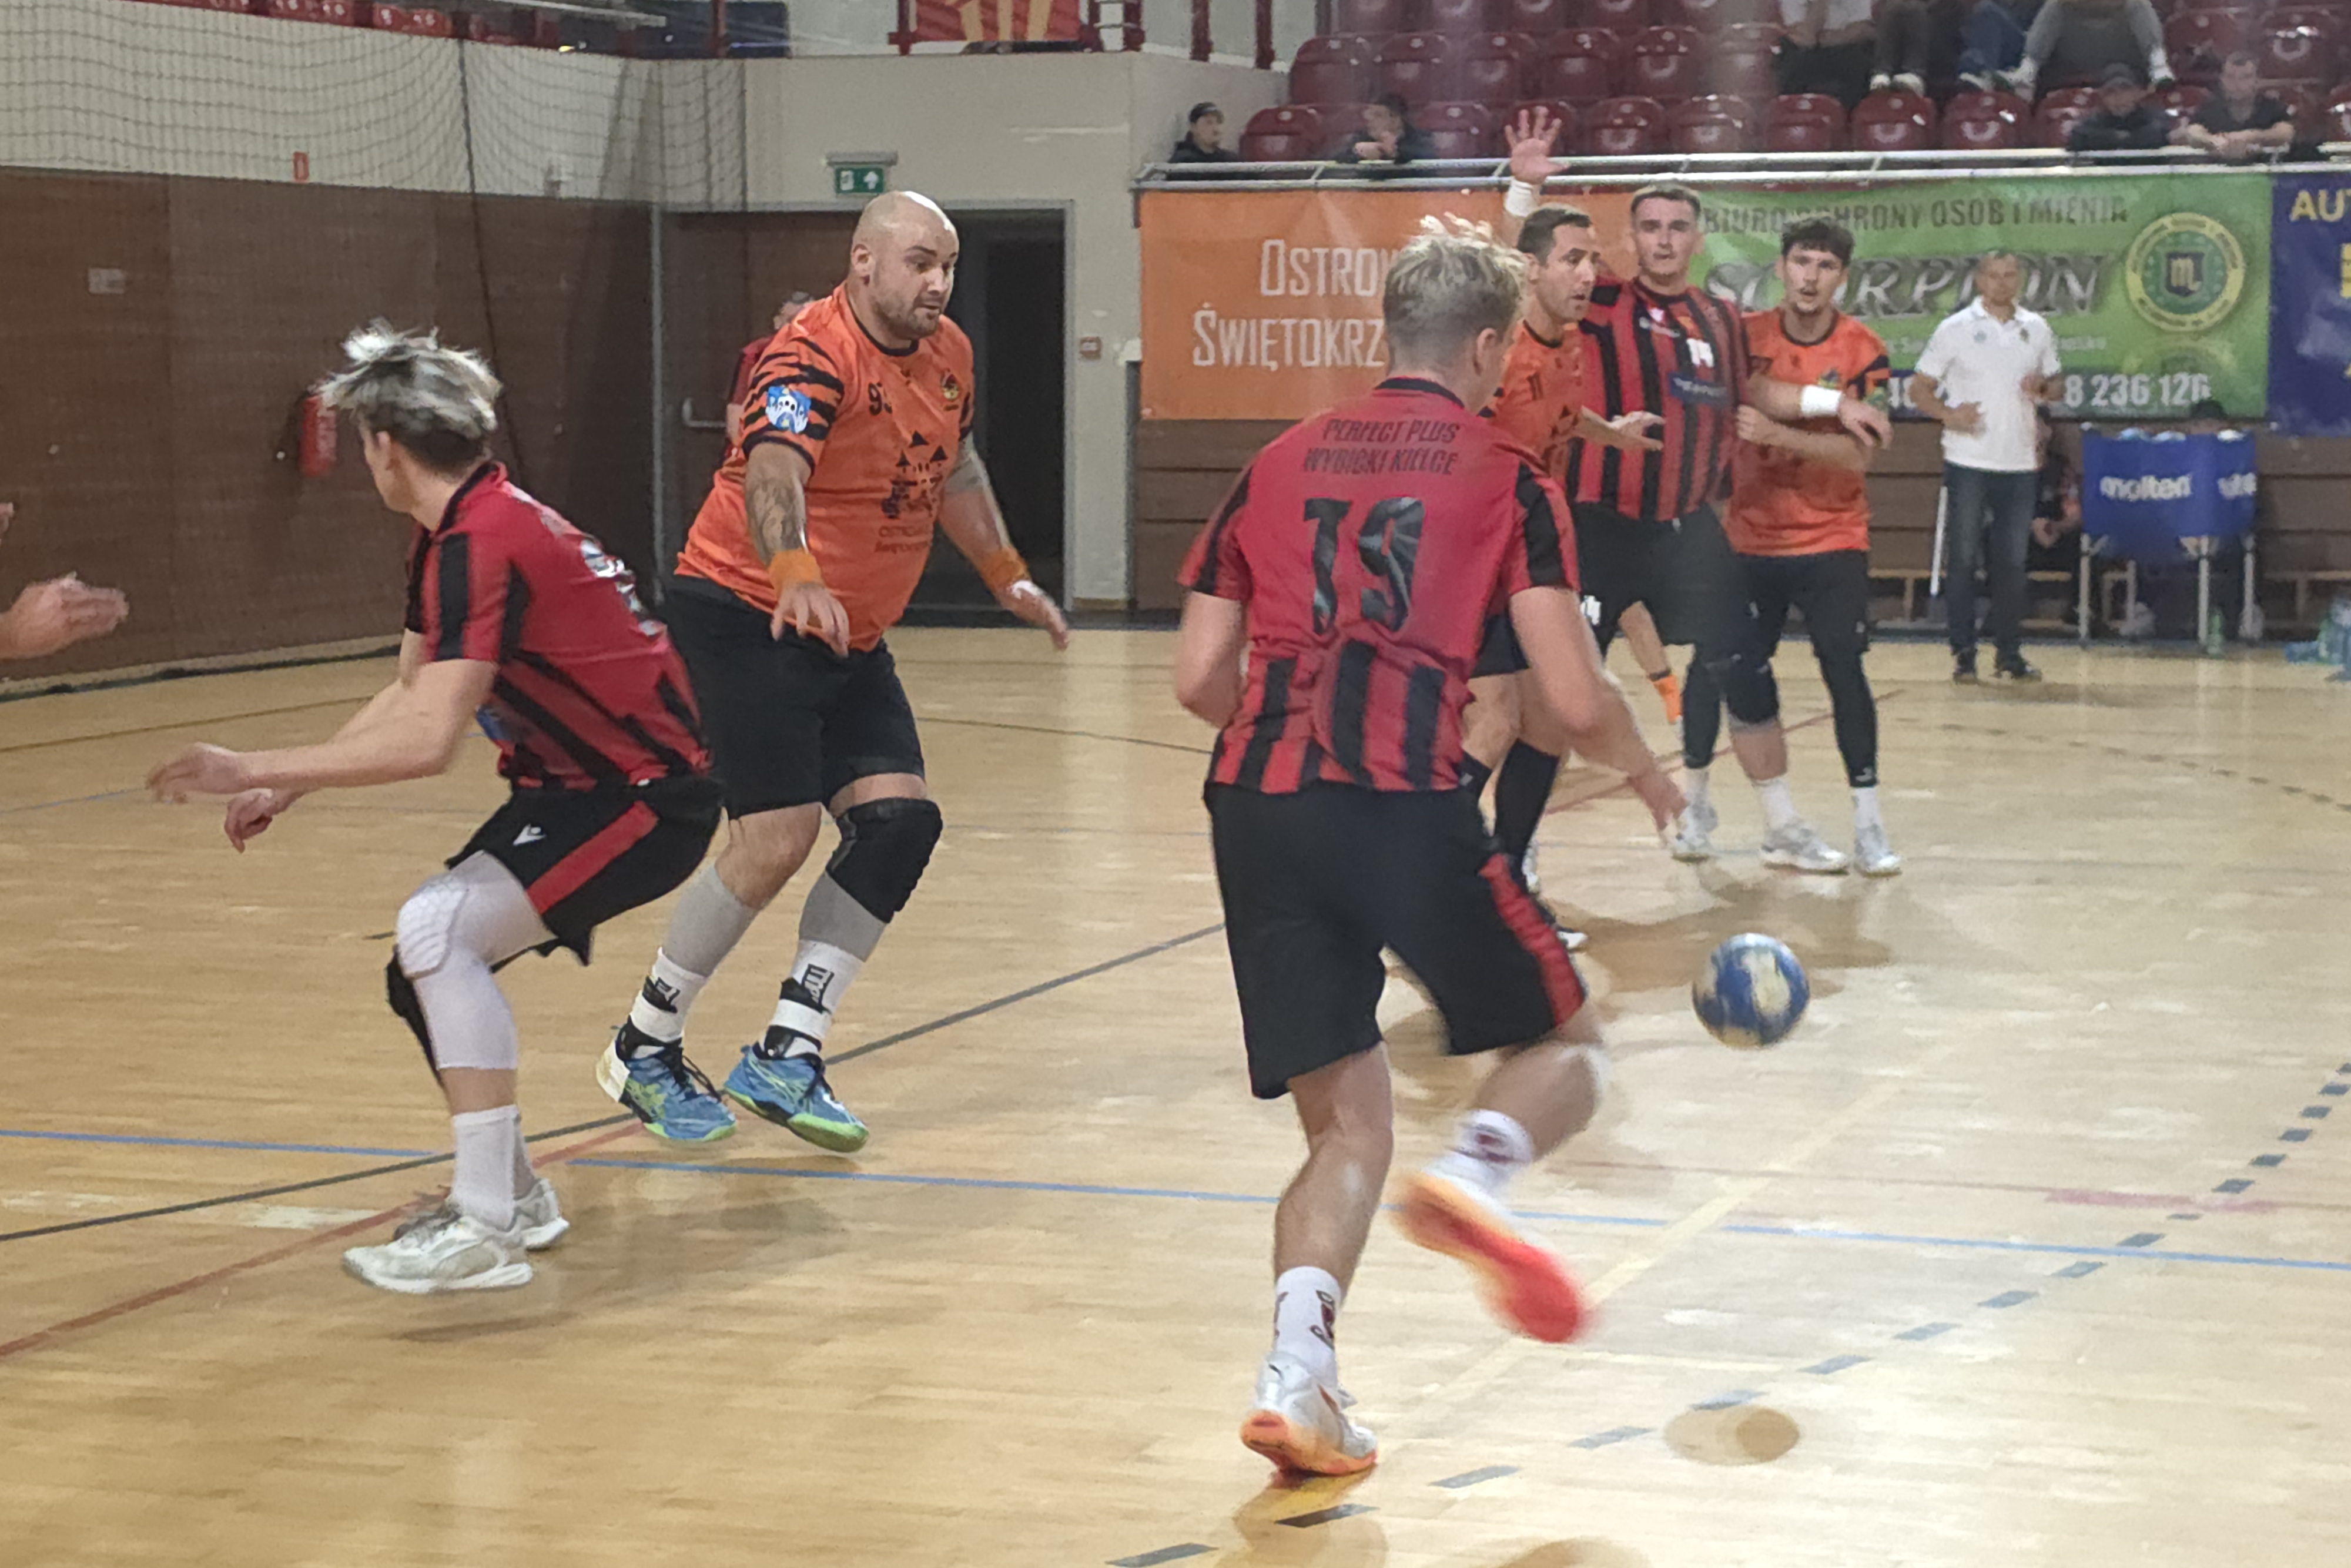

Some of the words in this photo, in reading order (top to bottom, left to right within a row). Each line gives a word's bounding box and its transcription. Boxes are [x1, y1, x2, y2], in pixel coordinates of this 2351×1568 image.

[1930, 198, 2005, 228] OSOB
[2290, 189, 2351, 222] AU
[2090, 373, 2151, 407] 236
[1321, 418, 1409, 443] PERFECT
[1405, 418, 1460, 444] PLUS
[1389, 447, 1459, 475] KIELCE
